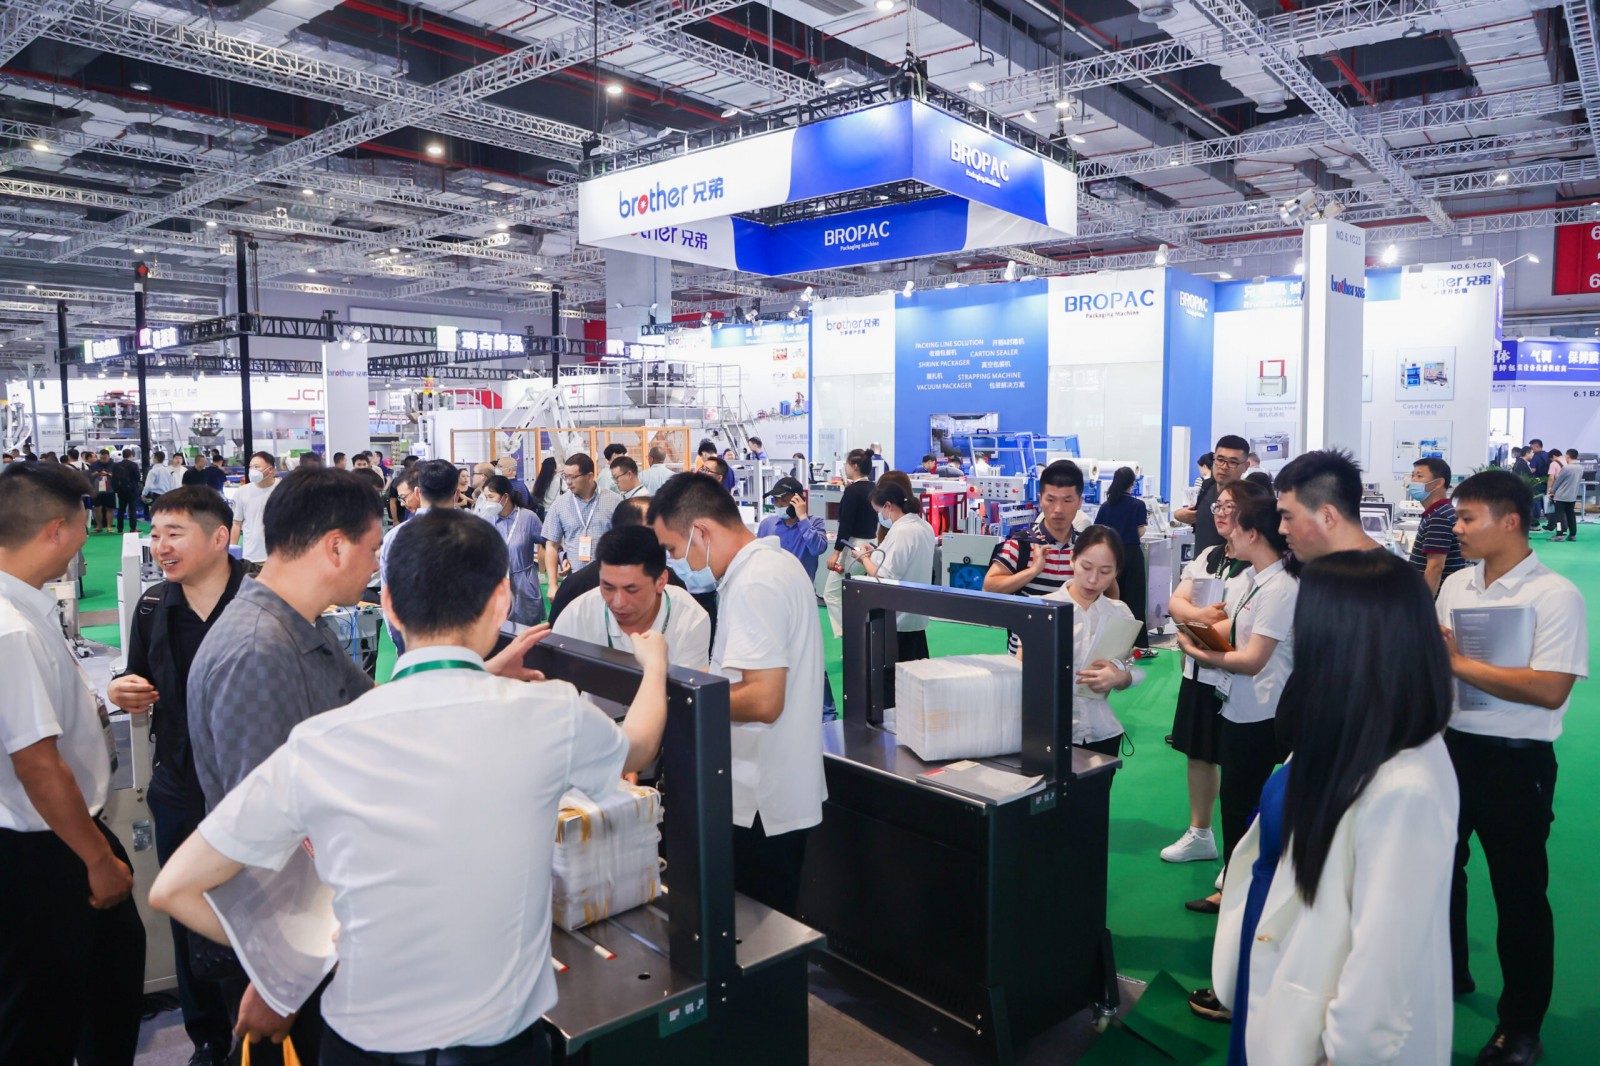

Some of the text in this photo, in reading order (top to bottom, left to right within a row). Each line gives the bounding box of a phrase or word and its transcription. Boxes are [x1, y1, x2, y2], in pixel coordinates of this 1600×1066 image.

[951, 139, 1010, 182] BROPAC
[619, 177, 724, 219] brother 兄弟
[681, 229, 708, 250] 兄弟
[824, 220, 890, 246] BROPAC
[1335, 230, 1361, 246] NO.6.1C23
[840, 240, 879, 251] Packaging Machine
[1450, 261, 1492, 270] NO.6.1C23
[1331, 274, 1354, 296] brother
[1466, 274, 1491, 286] 兄弟
[1064, 289, 1154, 313] BROPAC
[1179, 291, 1208, 313] BROPAC
[826, 317, 880, 331] brother 兄弟
[915, 339, 984, 349] PACKING LINE SOLUTION
[970, 348, 1018, 358] CARTON SEALER
[918, 359, 970, 368] SHRINK PACKAGER
[327, 368, 354, 377] brother
[957, 371, 1021, 381] STRAPPING MACHINE
[917, 382, 972, 391] VACUUM PACKAGER
